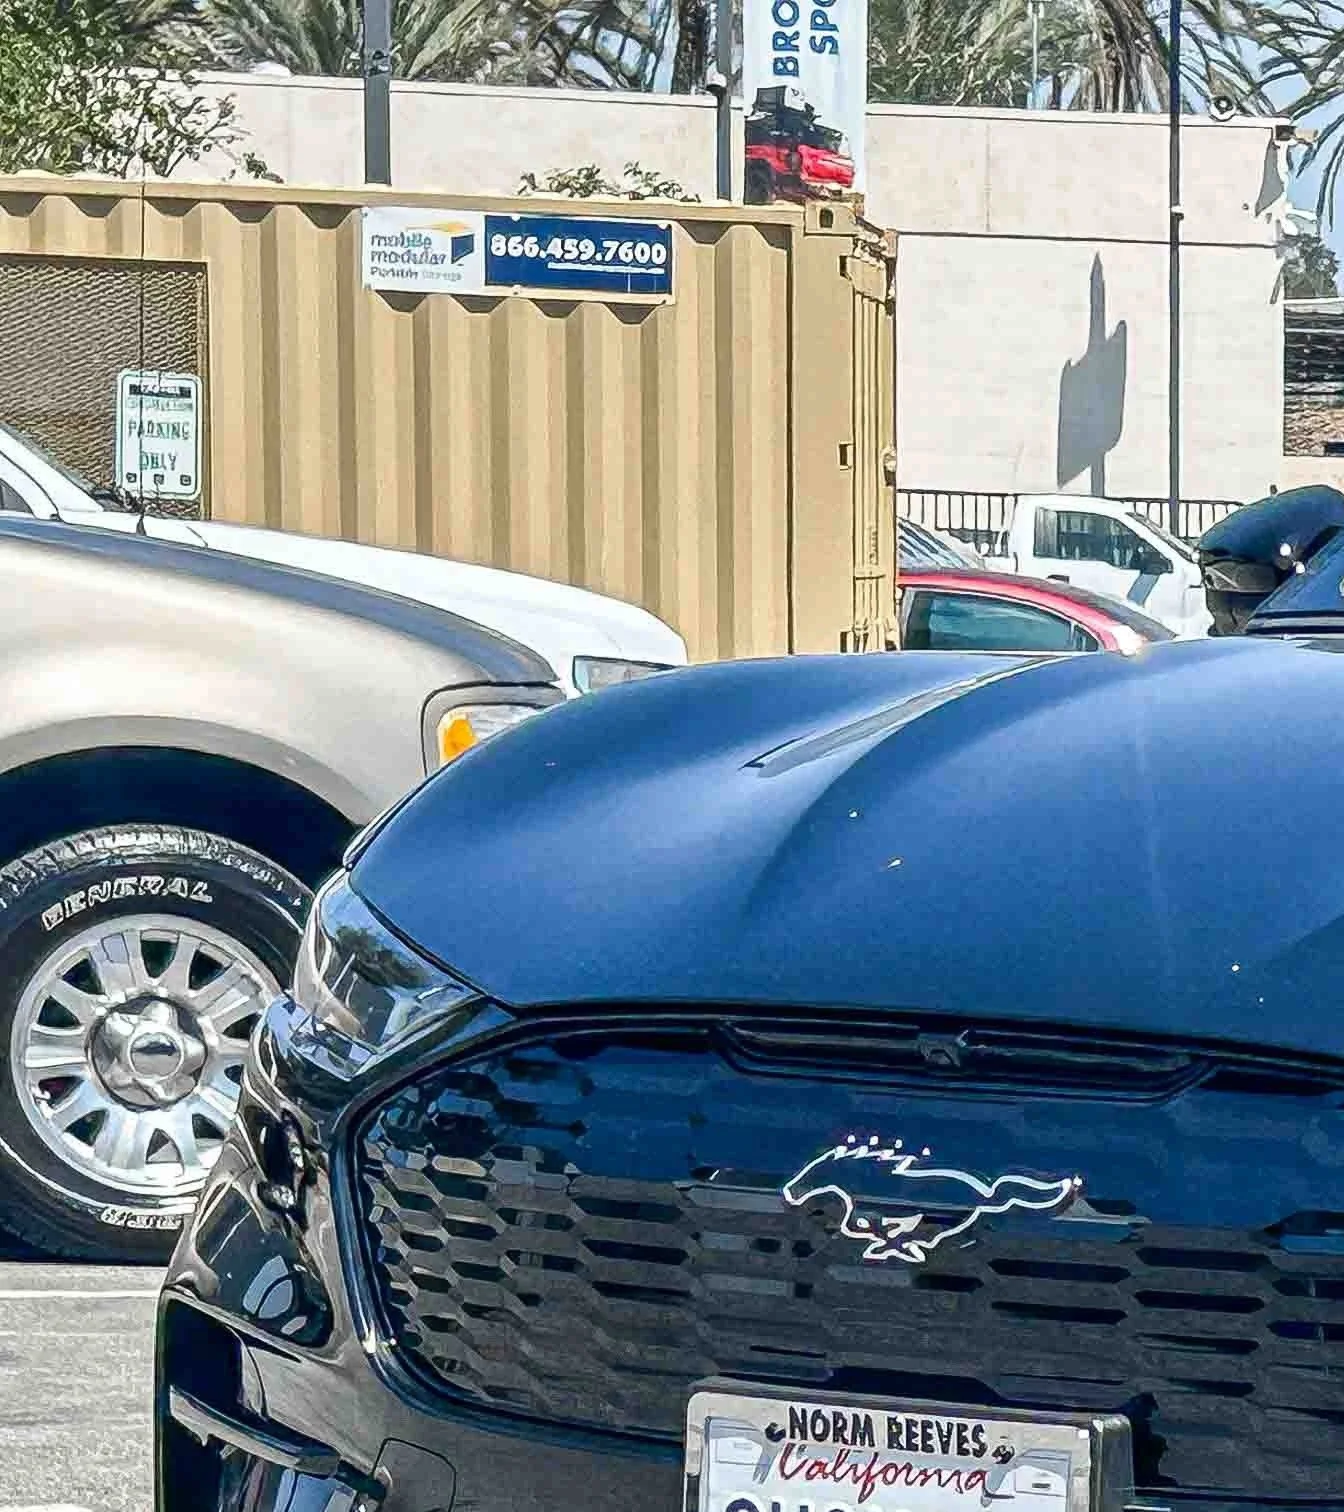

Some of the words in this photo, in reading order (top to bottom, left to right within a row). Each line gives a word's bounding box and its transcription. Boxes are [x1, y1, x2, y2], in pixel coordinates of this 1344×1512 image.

[490, 233, 667, 265] 866.459.7600
[41, 874, 213, 932] GENERAL
[788, 1406, 876, 1449] NORM
[887, 1415, 986, 1458] REEVES
[777, 1441, 990, 1504] California
